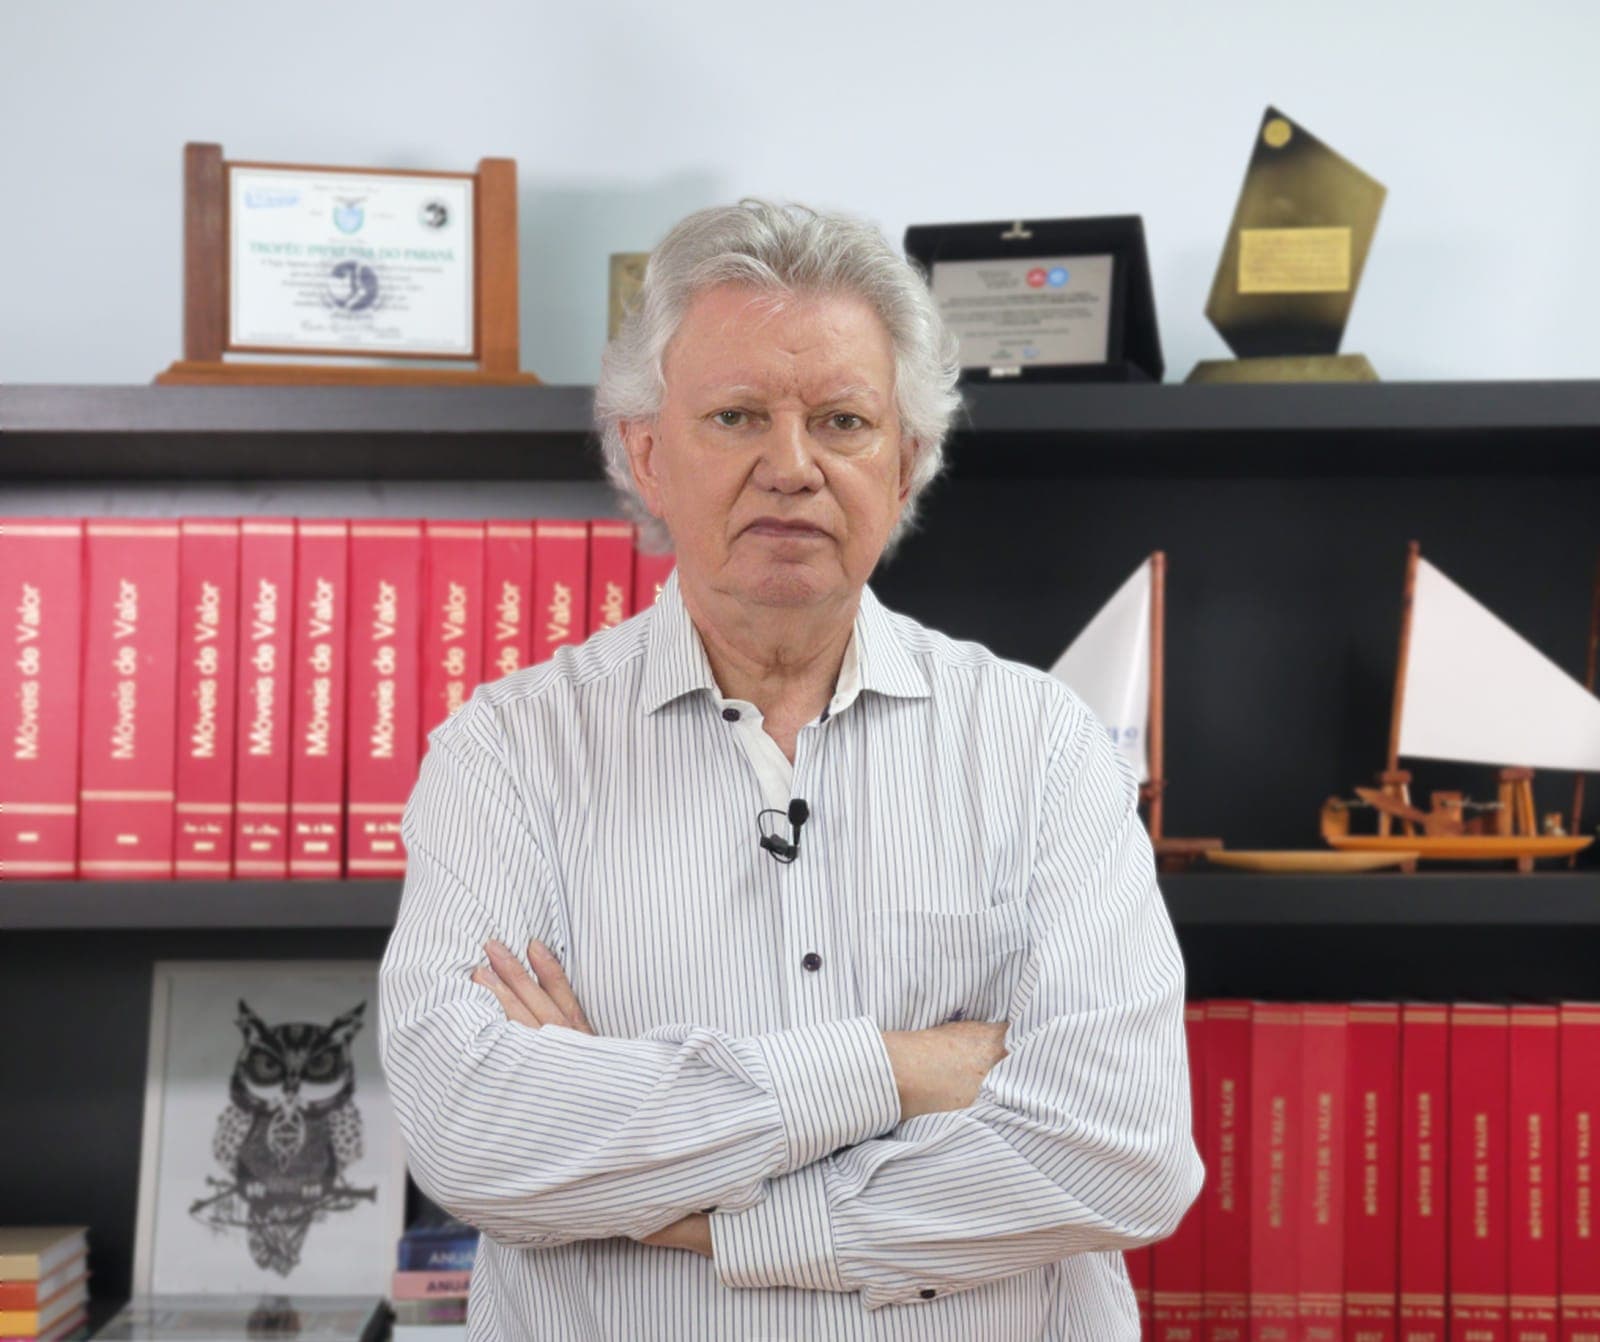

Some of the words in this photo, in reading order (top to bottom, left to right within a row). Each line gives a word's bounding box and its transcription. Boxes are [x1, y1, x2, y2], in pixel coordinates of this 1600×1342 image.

[16, 583, 40, 642] Valor
[114, 579, 138, 638] Valor
[195, 582, 220, 641] Valor
[252, 580, 277, 639] Valor
[309, 578, 334, 636] Valor
[373, 581, 397, 639] Valor
[443, 582, 466, 641] Valor
[496, 581, 520, 641] Valor
[547, 582, 571, 642] Valor
[16, 647, 39, 675] de
[113, 647, 136, 675] de
[194, 646, 218, 674] de
[250, 645, 275, 673] de
[308, 644, 332, 672] de
[373, 646, 395, 674] de
[443, 647, 465, 675] de
[496, 647, 519, 674] de
[14, 681, 39, 760] Móveis
[111, 681, 136, 760] Móveis
[192, 679, 217, 758] Móveis
[248, 678, 274, 756] Móveis
[305, 678, 331, 756] Móveis
[370, 680, 394, 758] Móveis
